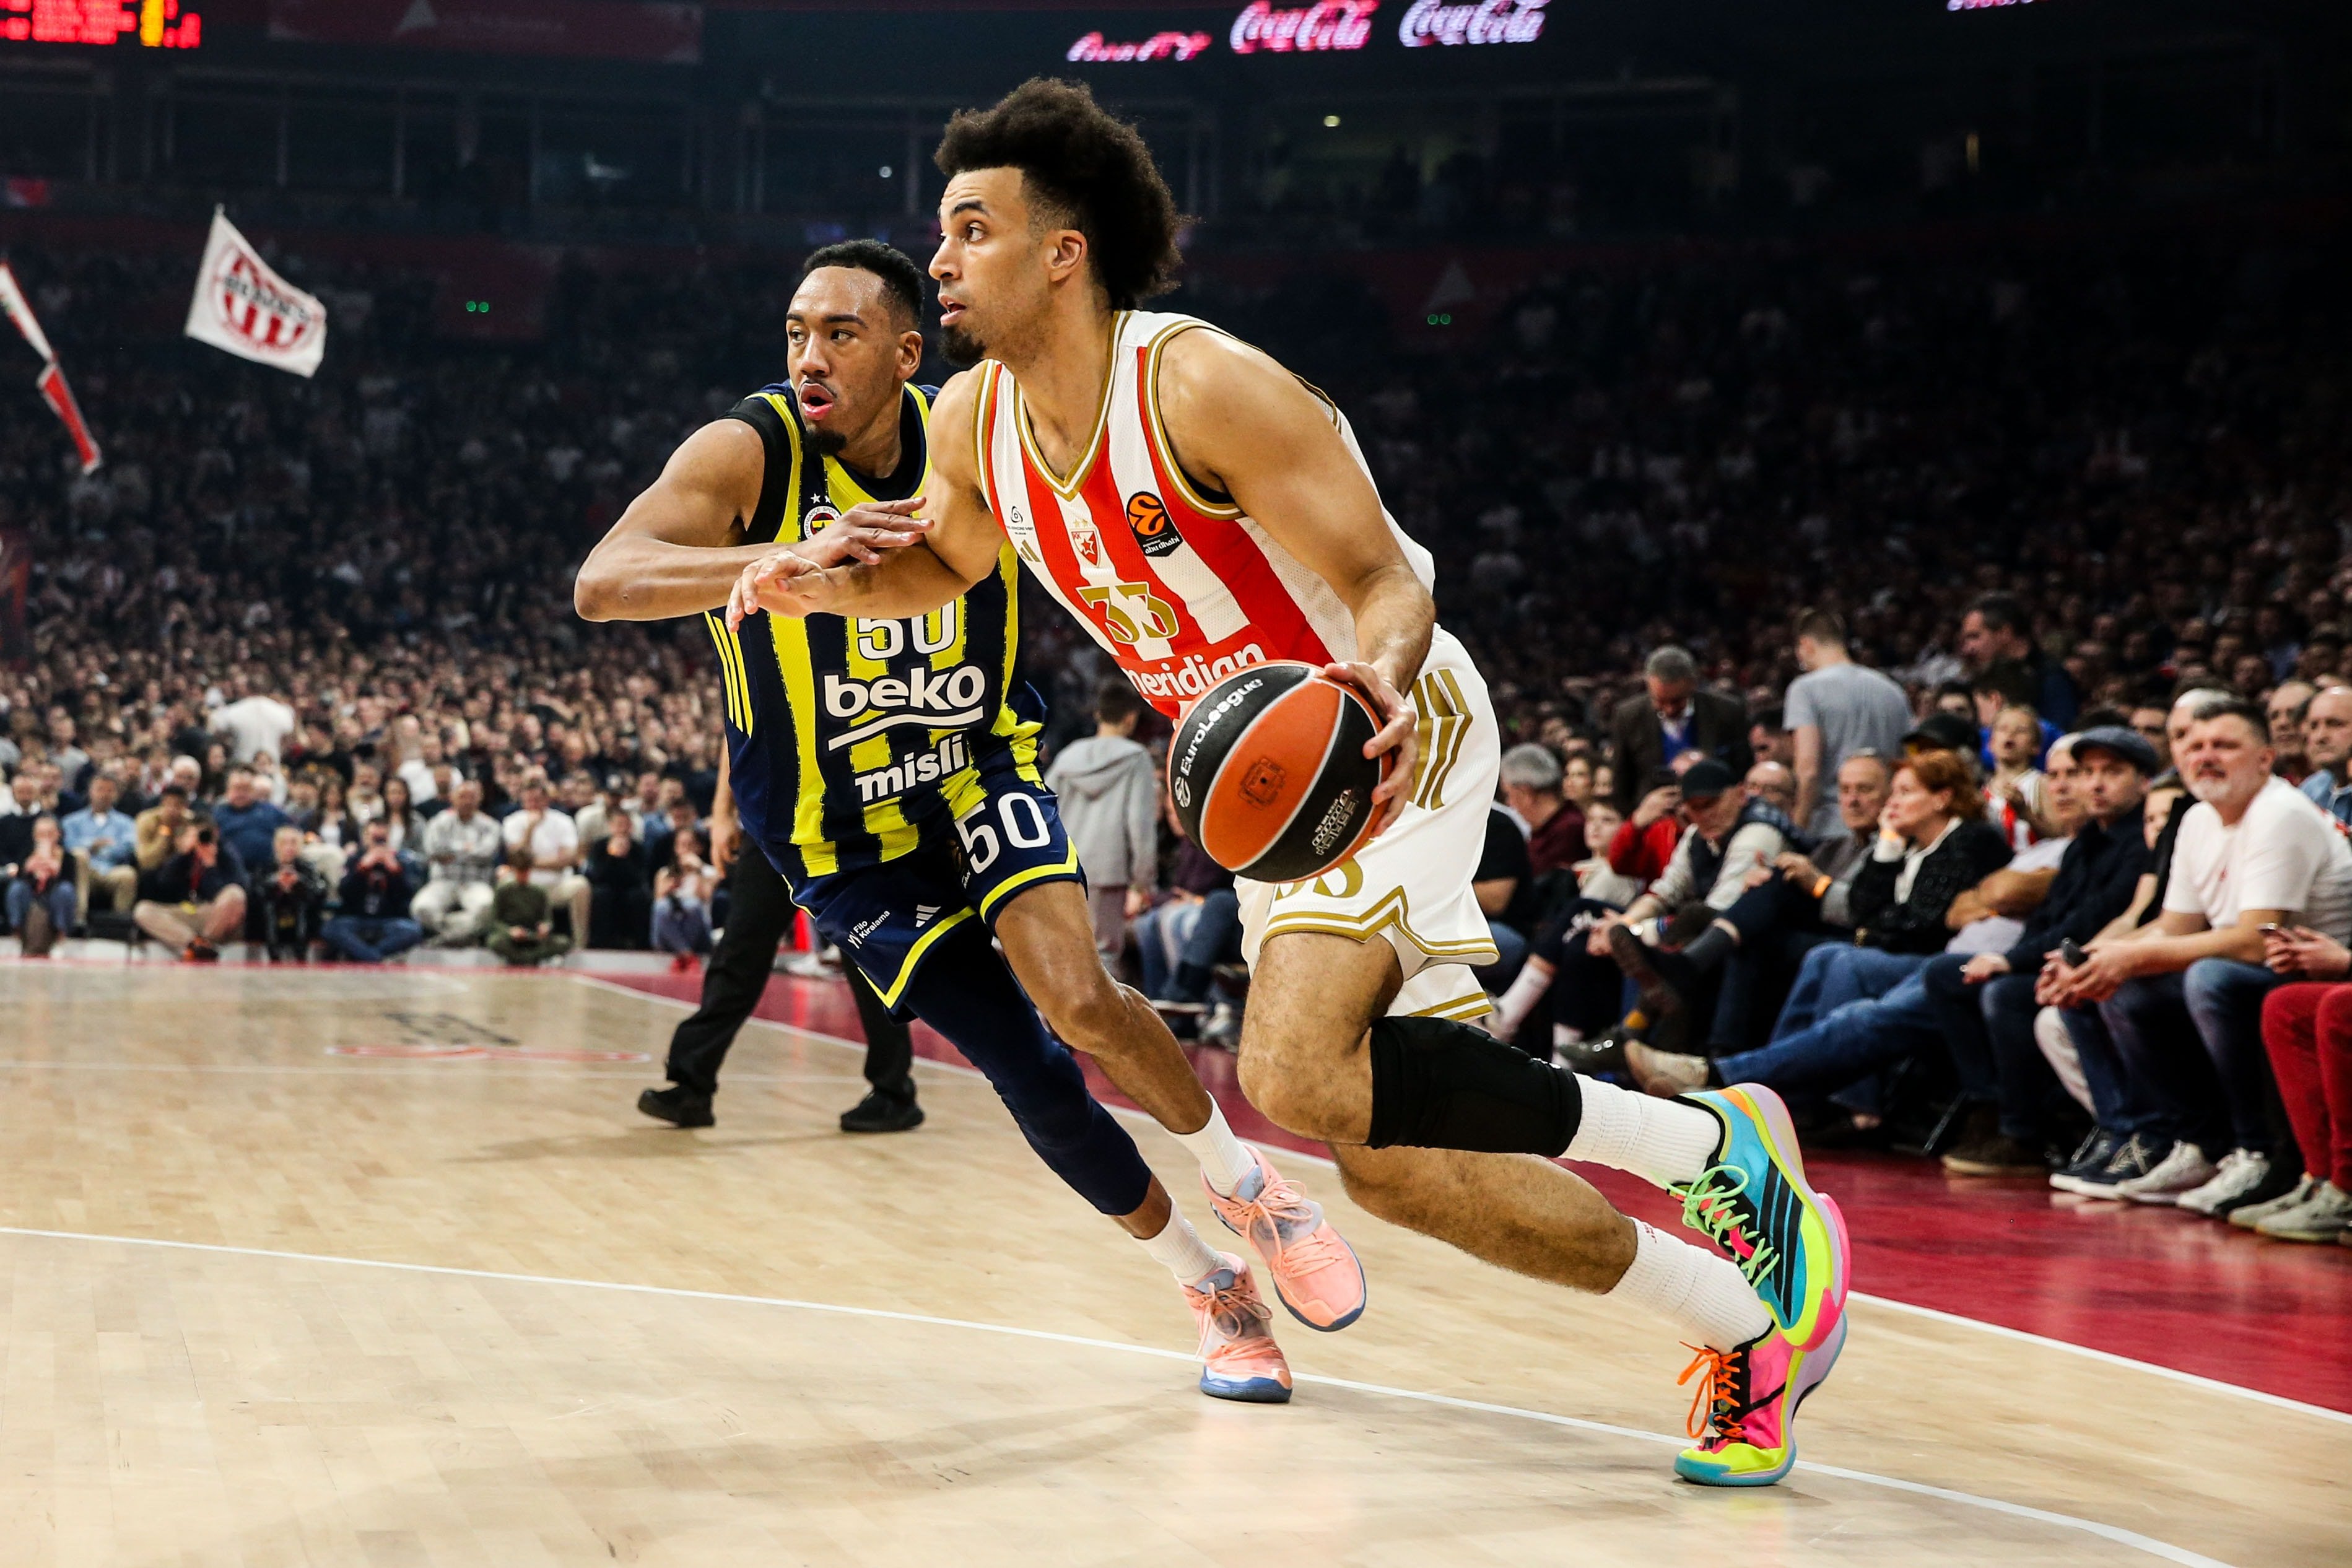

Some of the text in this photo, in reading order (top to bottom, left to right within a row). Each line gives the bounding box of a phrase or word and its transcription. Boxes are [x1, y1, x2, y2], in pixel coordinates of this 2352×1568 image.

[1145, 546, 1159, 554] abu
[1158, 535, 1180, 549] dhabi
[858, 601, 956, 660] 50
[1076, 581, 1180, 645] 33
[824, 666, 985, 718] beko
[855, 733, 965, 802] misli
[954, 792, 1051, 874] 50
[859, 910, 891, 939] Kiralama
